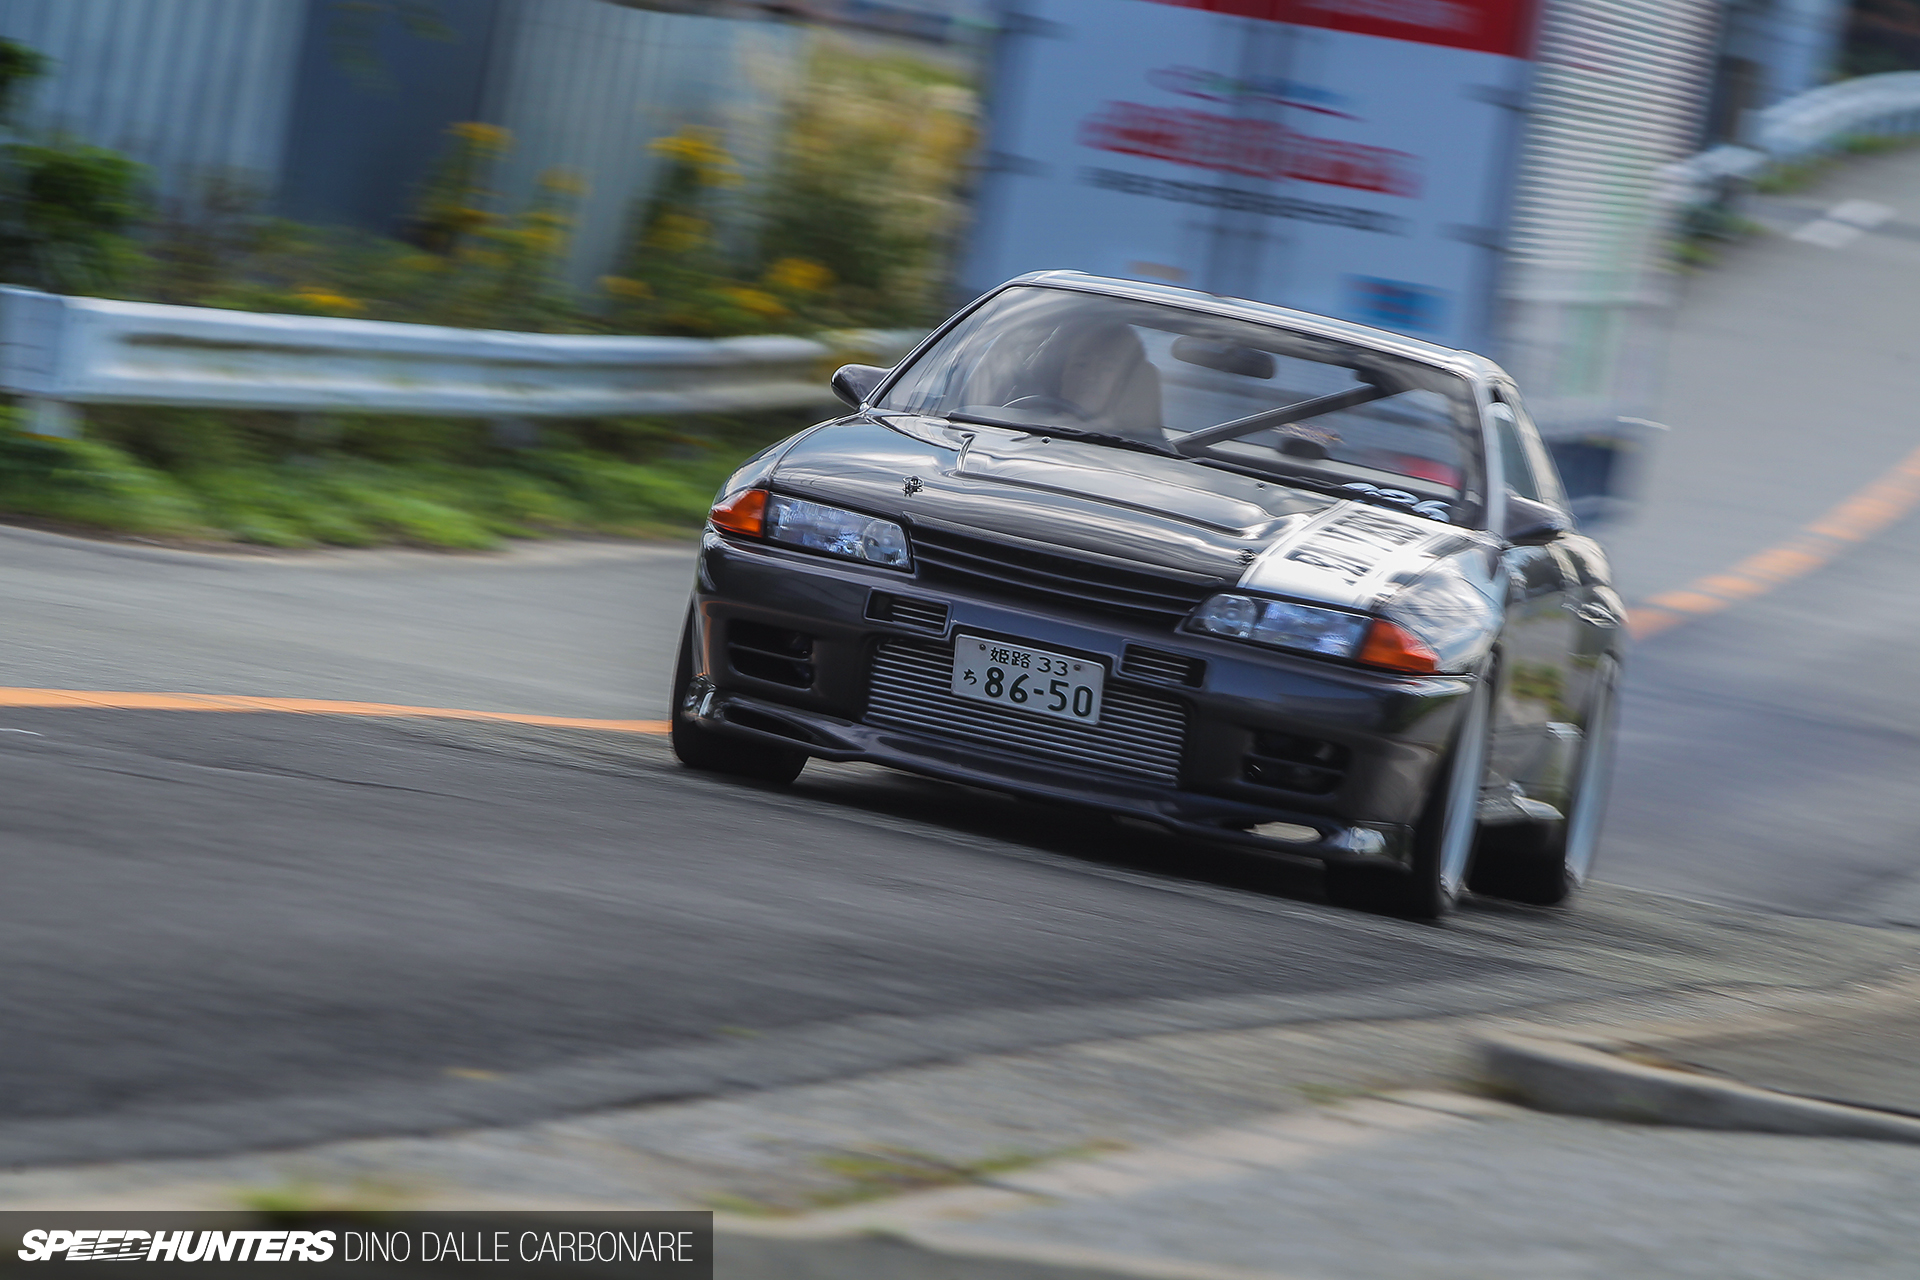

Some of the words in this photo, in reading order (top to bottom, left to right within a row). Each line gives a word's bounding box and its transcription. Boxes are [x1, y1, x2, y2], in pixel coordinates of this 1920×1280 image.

[990, 647, 1031, 669] 姫路
[1037, 657, 1069, 676] 33
[963, 669, 977, 685] ち
[984, 667, 1093, 717] 86-50
